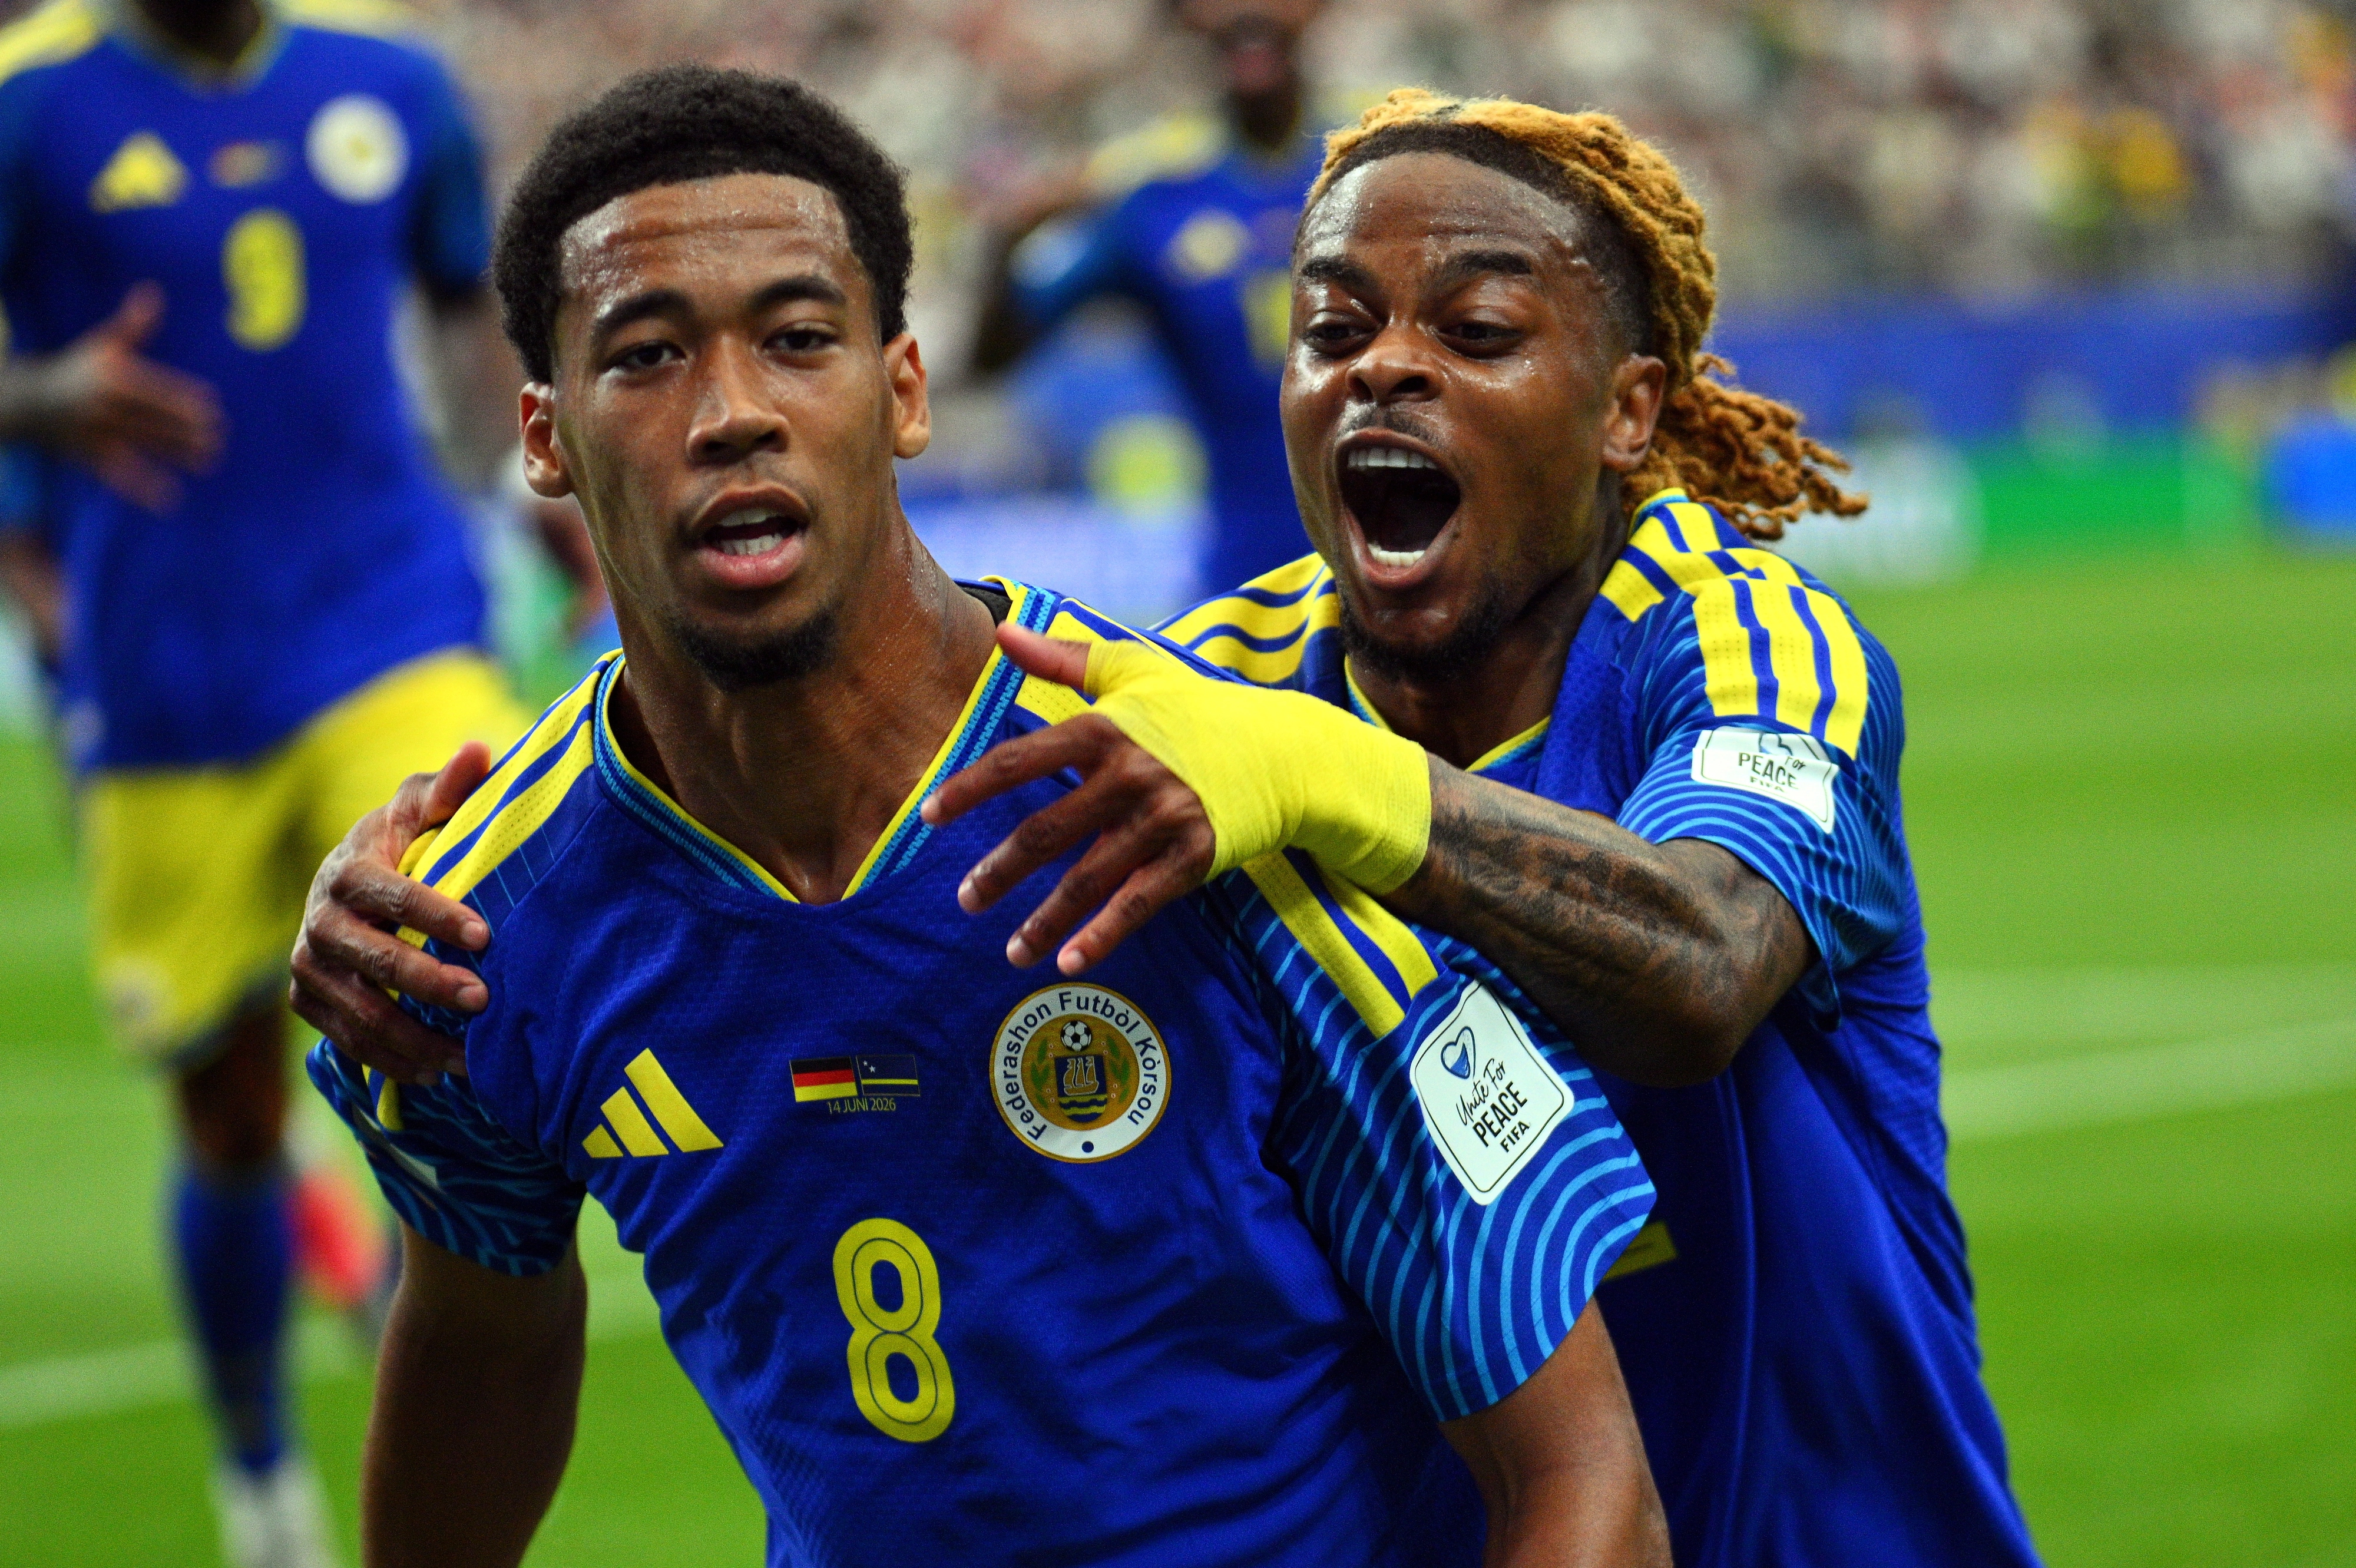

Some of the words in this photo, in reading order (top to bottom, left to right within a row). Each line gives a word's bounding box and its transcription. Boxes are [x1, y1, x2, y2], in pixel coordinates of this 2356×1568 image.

[1738, 752, 1799, 789] PEACE
[1003, 1002, 1053, 1140] Federashon
[1058, 991, 1140, 1034] Futbòl
[1127, 1037, 1161, 1126] Kòrsou
[1456, 1080, 1489, 1126] Unite
[1483, 1058, 1505, 1090] For
[826, 1100, 841, 1114] 14
[843, 1097, 868, 1113] JUNI
[871, 1097, 896, 1112] 2026
[1472, 1081, 1528, 1148] PEACE
[1500, 1121, 1530, 1153] FIFA
[832, 1218, 955, 1443] 8
